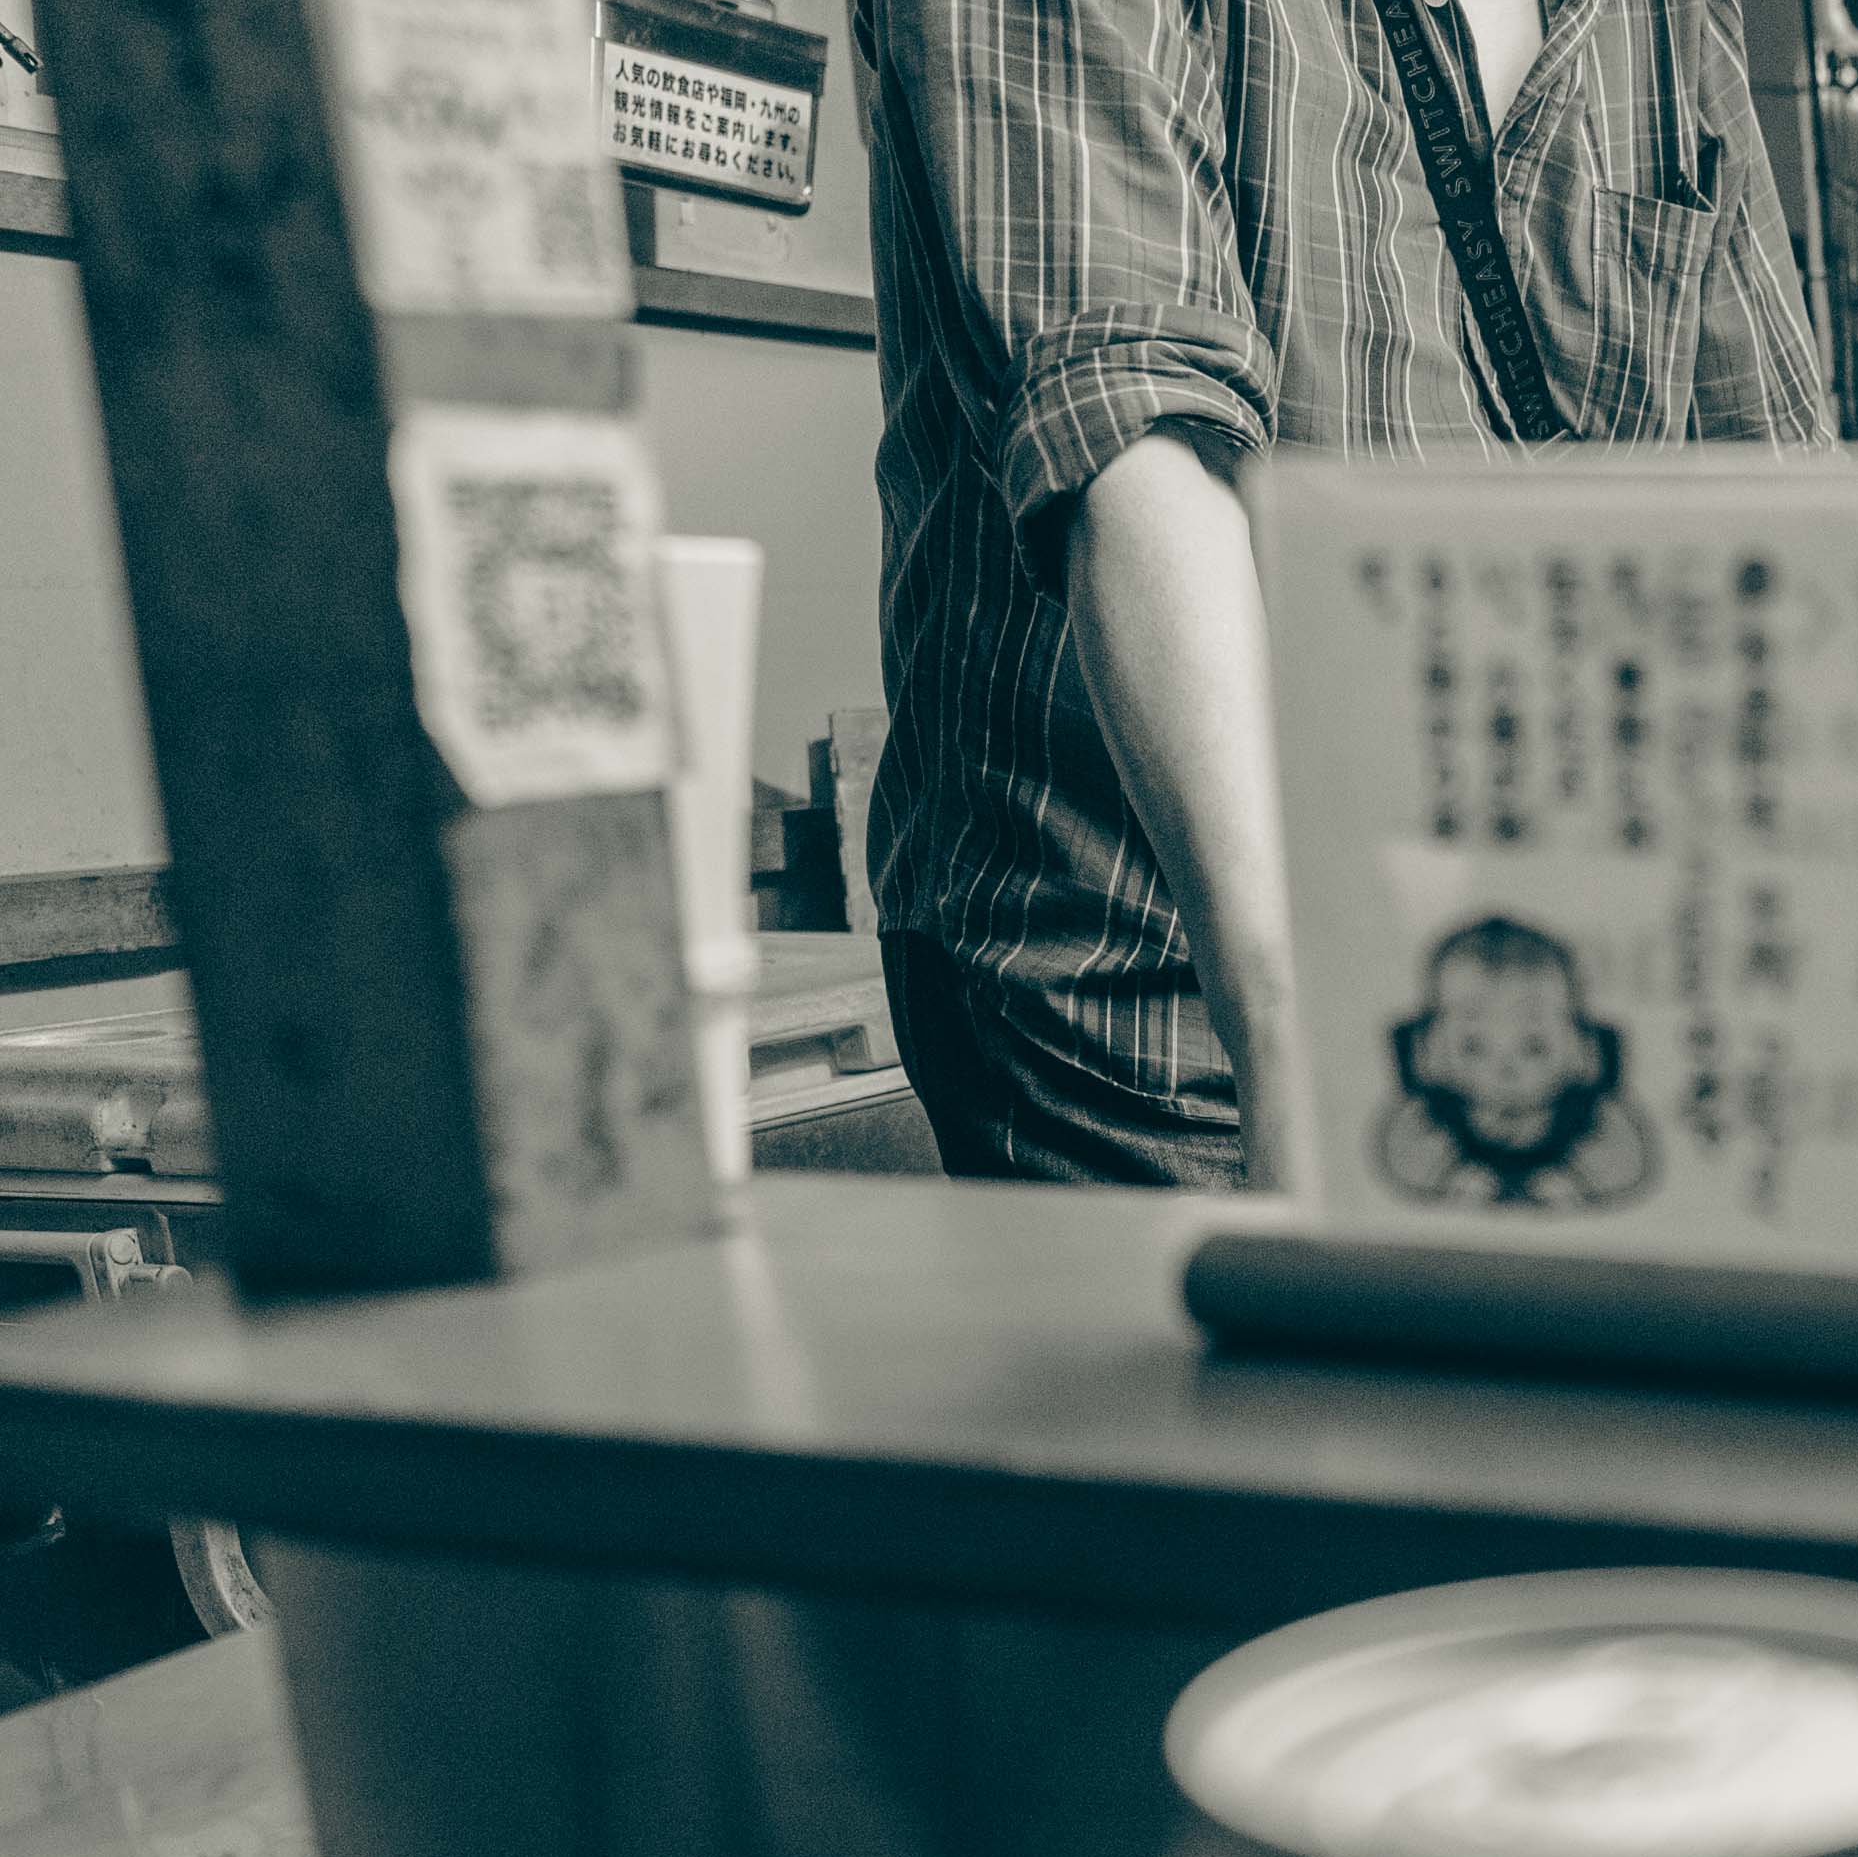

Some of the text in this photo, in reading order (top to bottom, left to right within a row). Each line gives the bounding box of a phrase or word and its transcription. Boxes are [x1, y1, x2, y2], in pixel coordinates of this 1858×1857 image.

[614, 89, 798, 156] 観光情報をご案内します。
[615, 58, 801, 125] 人気の飲食店や福岡・九州の
[612, 120, 796, 184] お気軽にお尋ねください。
[1456, 219, 1550, 441] SWITCHEASY
